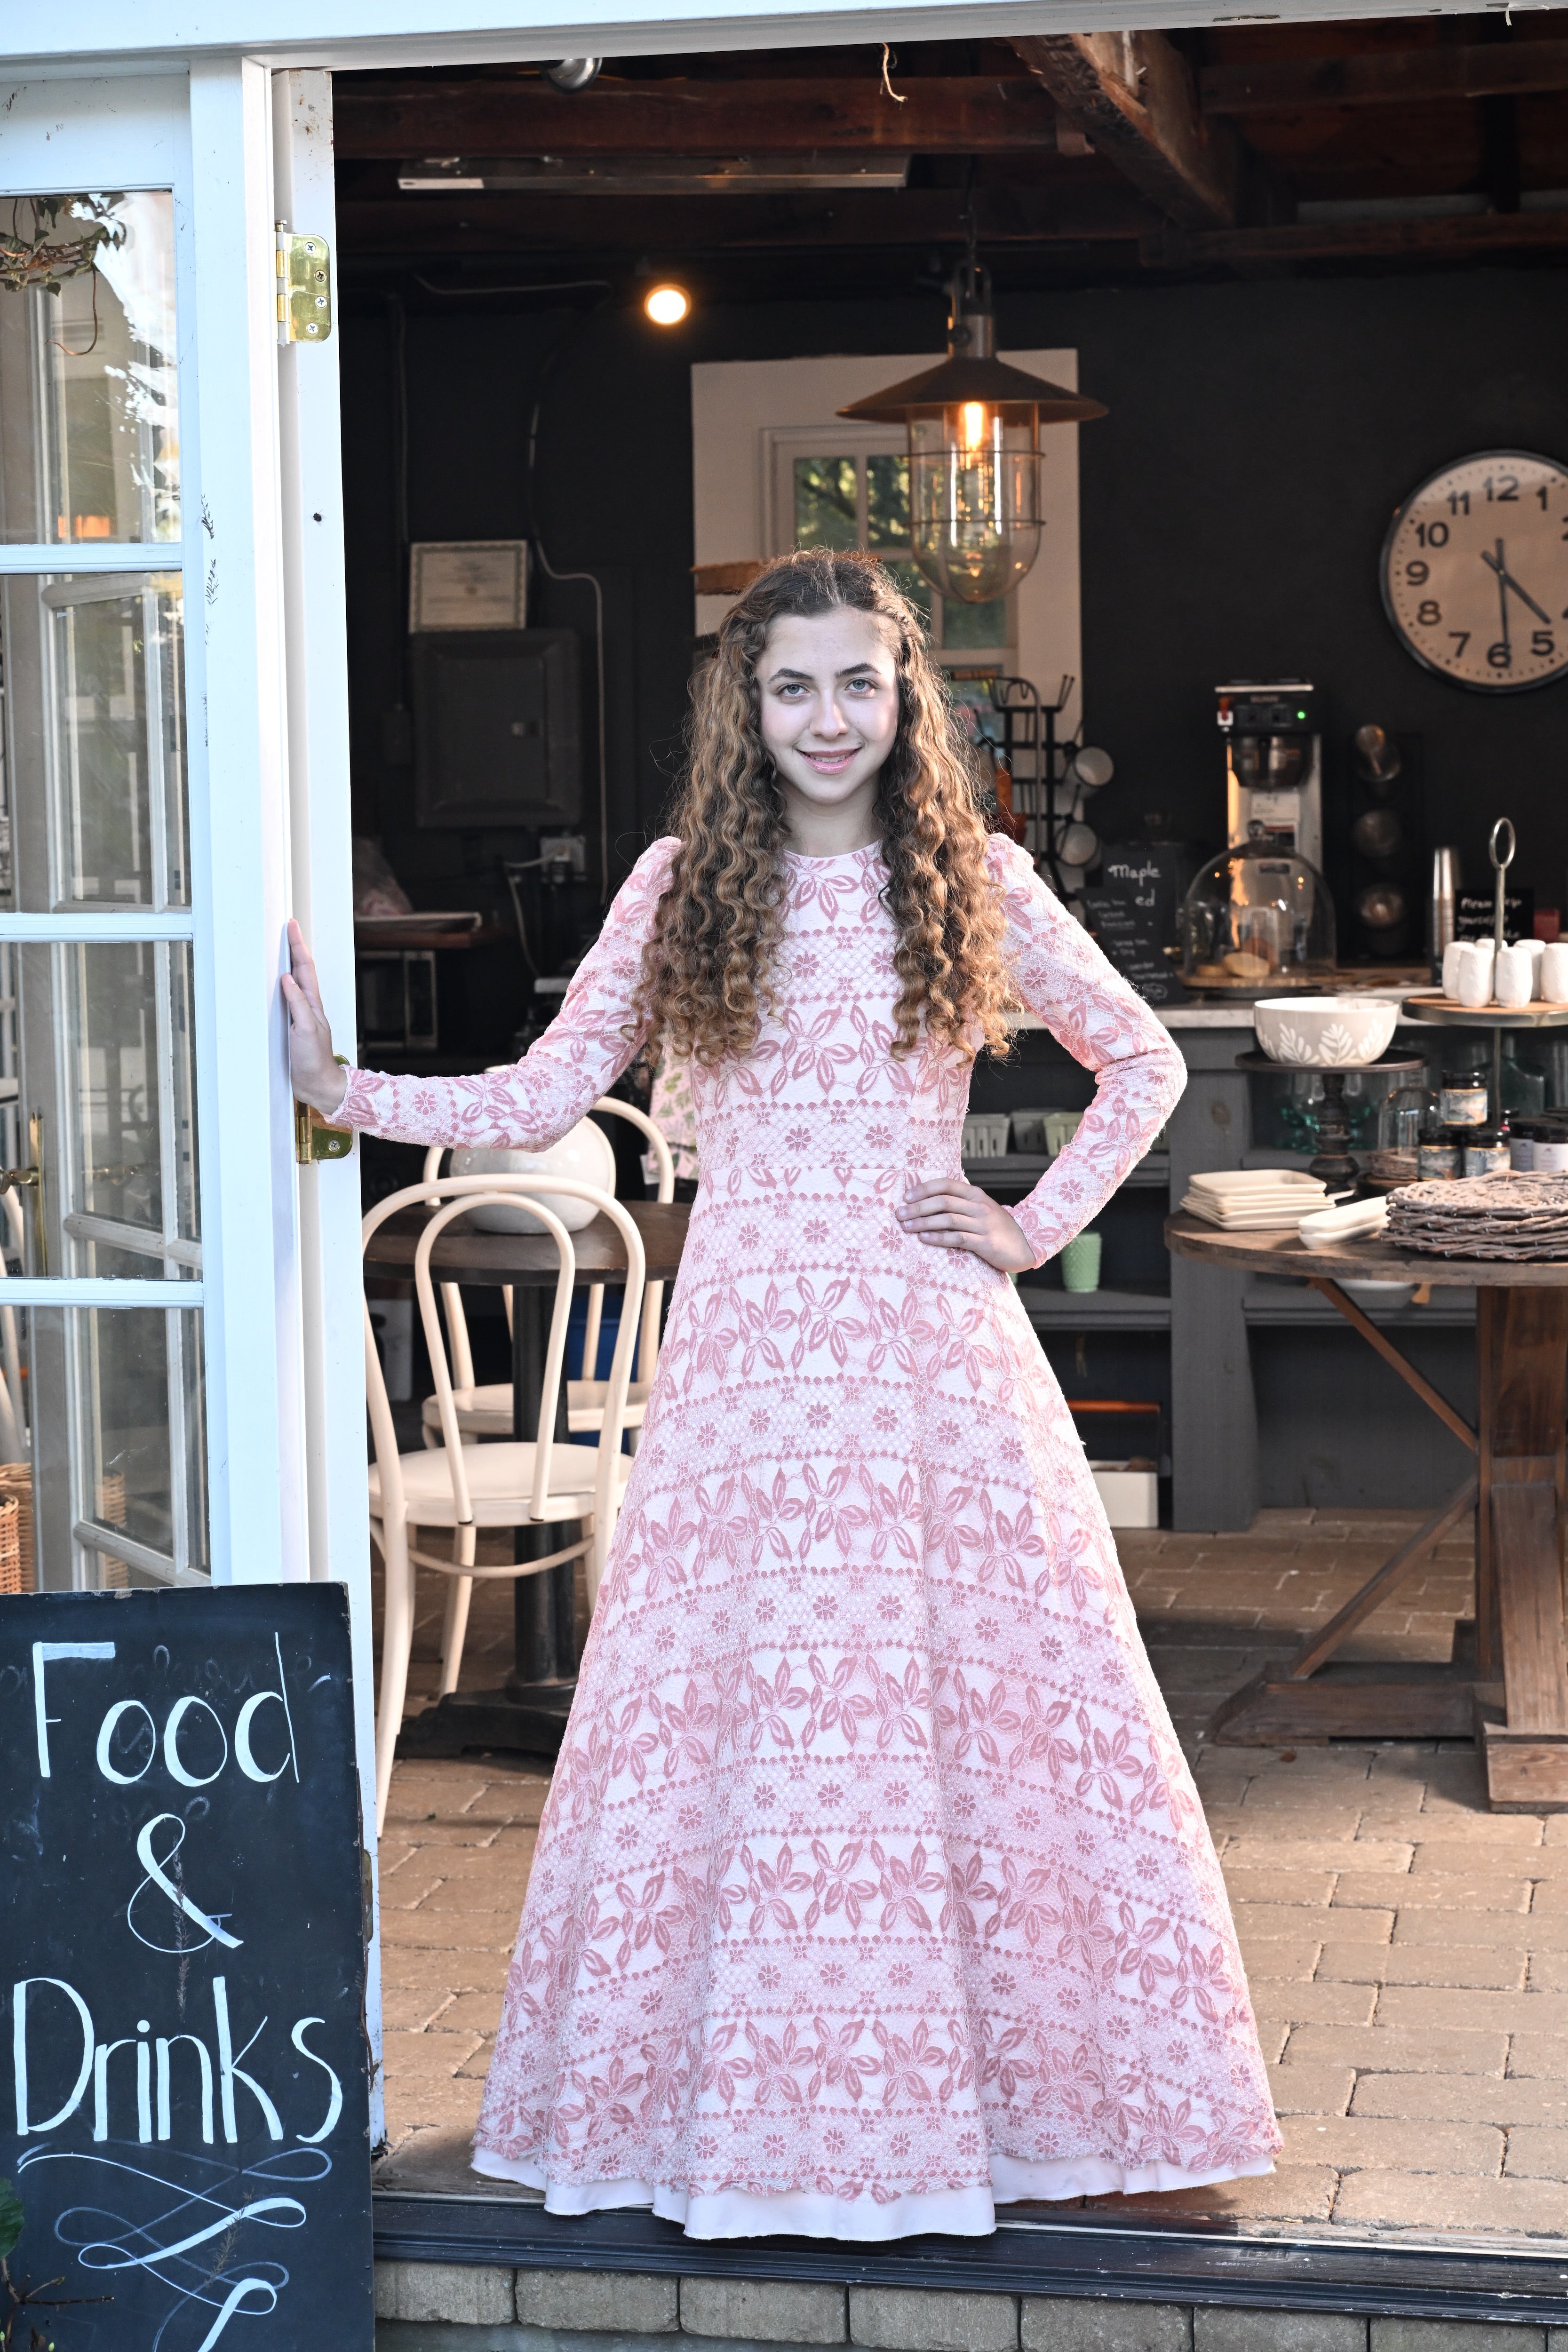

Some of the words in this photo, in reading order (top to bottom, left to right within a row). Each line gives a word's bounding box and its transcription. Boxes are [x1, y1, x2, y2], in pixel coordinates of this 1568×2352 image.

[1482, 475, 1520, 502] 12
[1536, 485, 1548, 511] 1
[1447, 490, 1471, 516] 11
[1415, 521, 1450, 548] 10
[1406, 560, 1430, 586] 9
[1417, 600, 1442, 626] 8
[1448, 631, 1472, 658] 7
[1486, 641, 1512, 669] 6
[1530, 630, 1555, 657] 5
[32, 1632, 300, 1787] Food
[127, 1813, 245, 1954] &
[13, 1976, 343, 2144] Drinks
